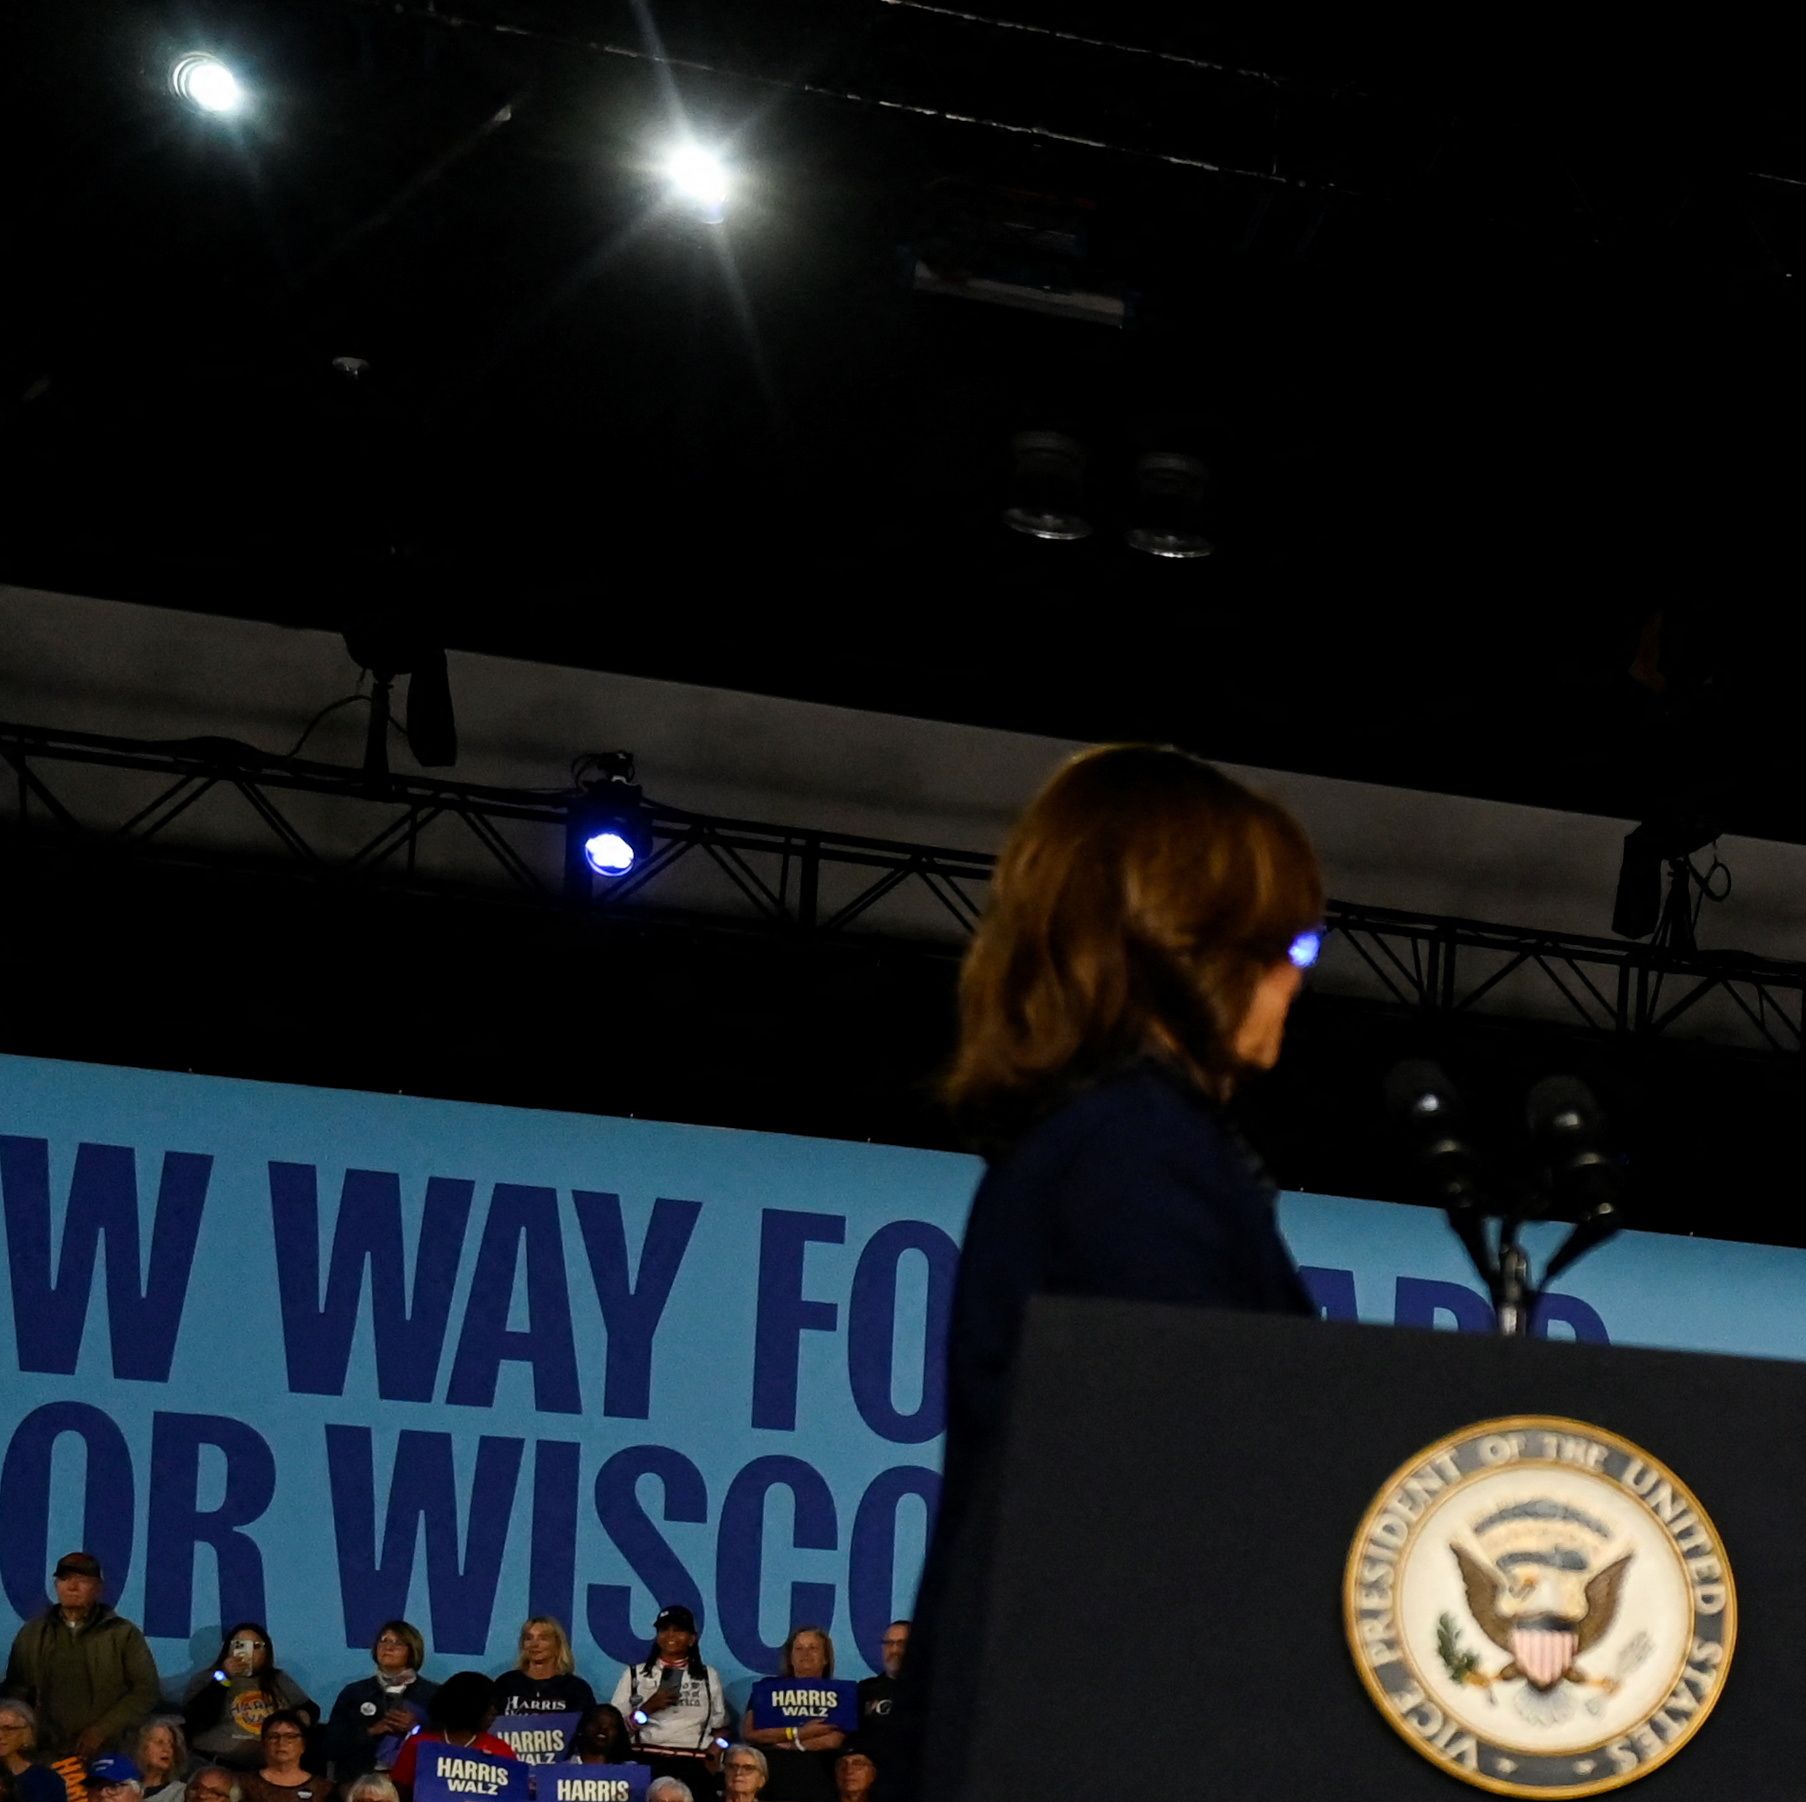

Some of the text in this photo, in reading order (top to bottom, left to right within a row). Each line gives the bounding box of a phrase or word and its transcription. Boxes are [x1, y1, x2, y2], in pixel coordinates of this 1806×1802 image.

[268, 1160, 702, 1420] WAY
[1357, 1435, 1728, 1775] VICE PRESIDENT OF THE UNITED STATES
[772, 1689, 838, 1708] HARRIS
[782, 1706, 829, 1719] WALZ
[437, 1757, 508, 1786] HARRIS
[447, 1778, 499, 1796] WALZ
[557, 1779, 629, 1802] HARRIS
